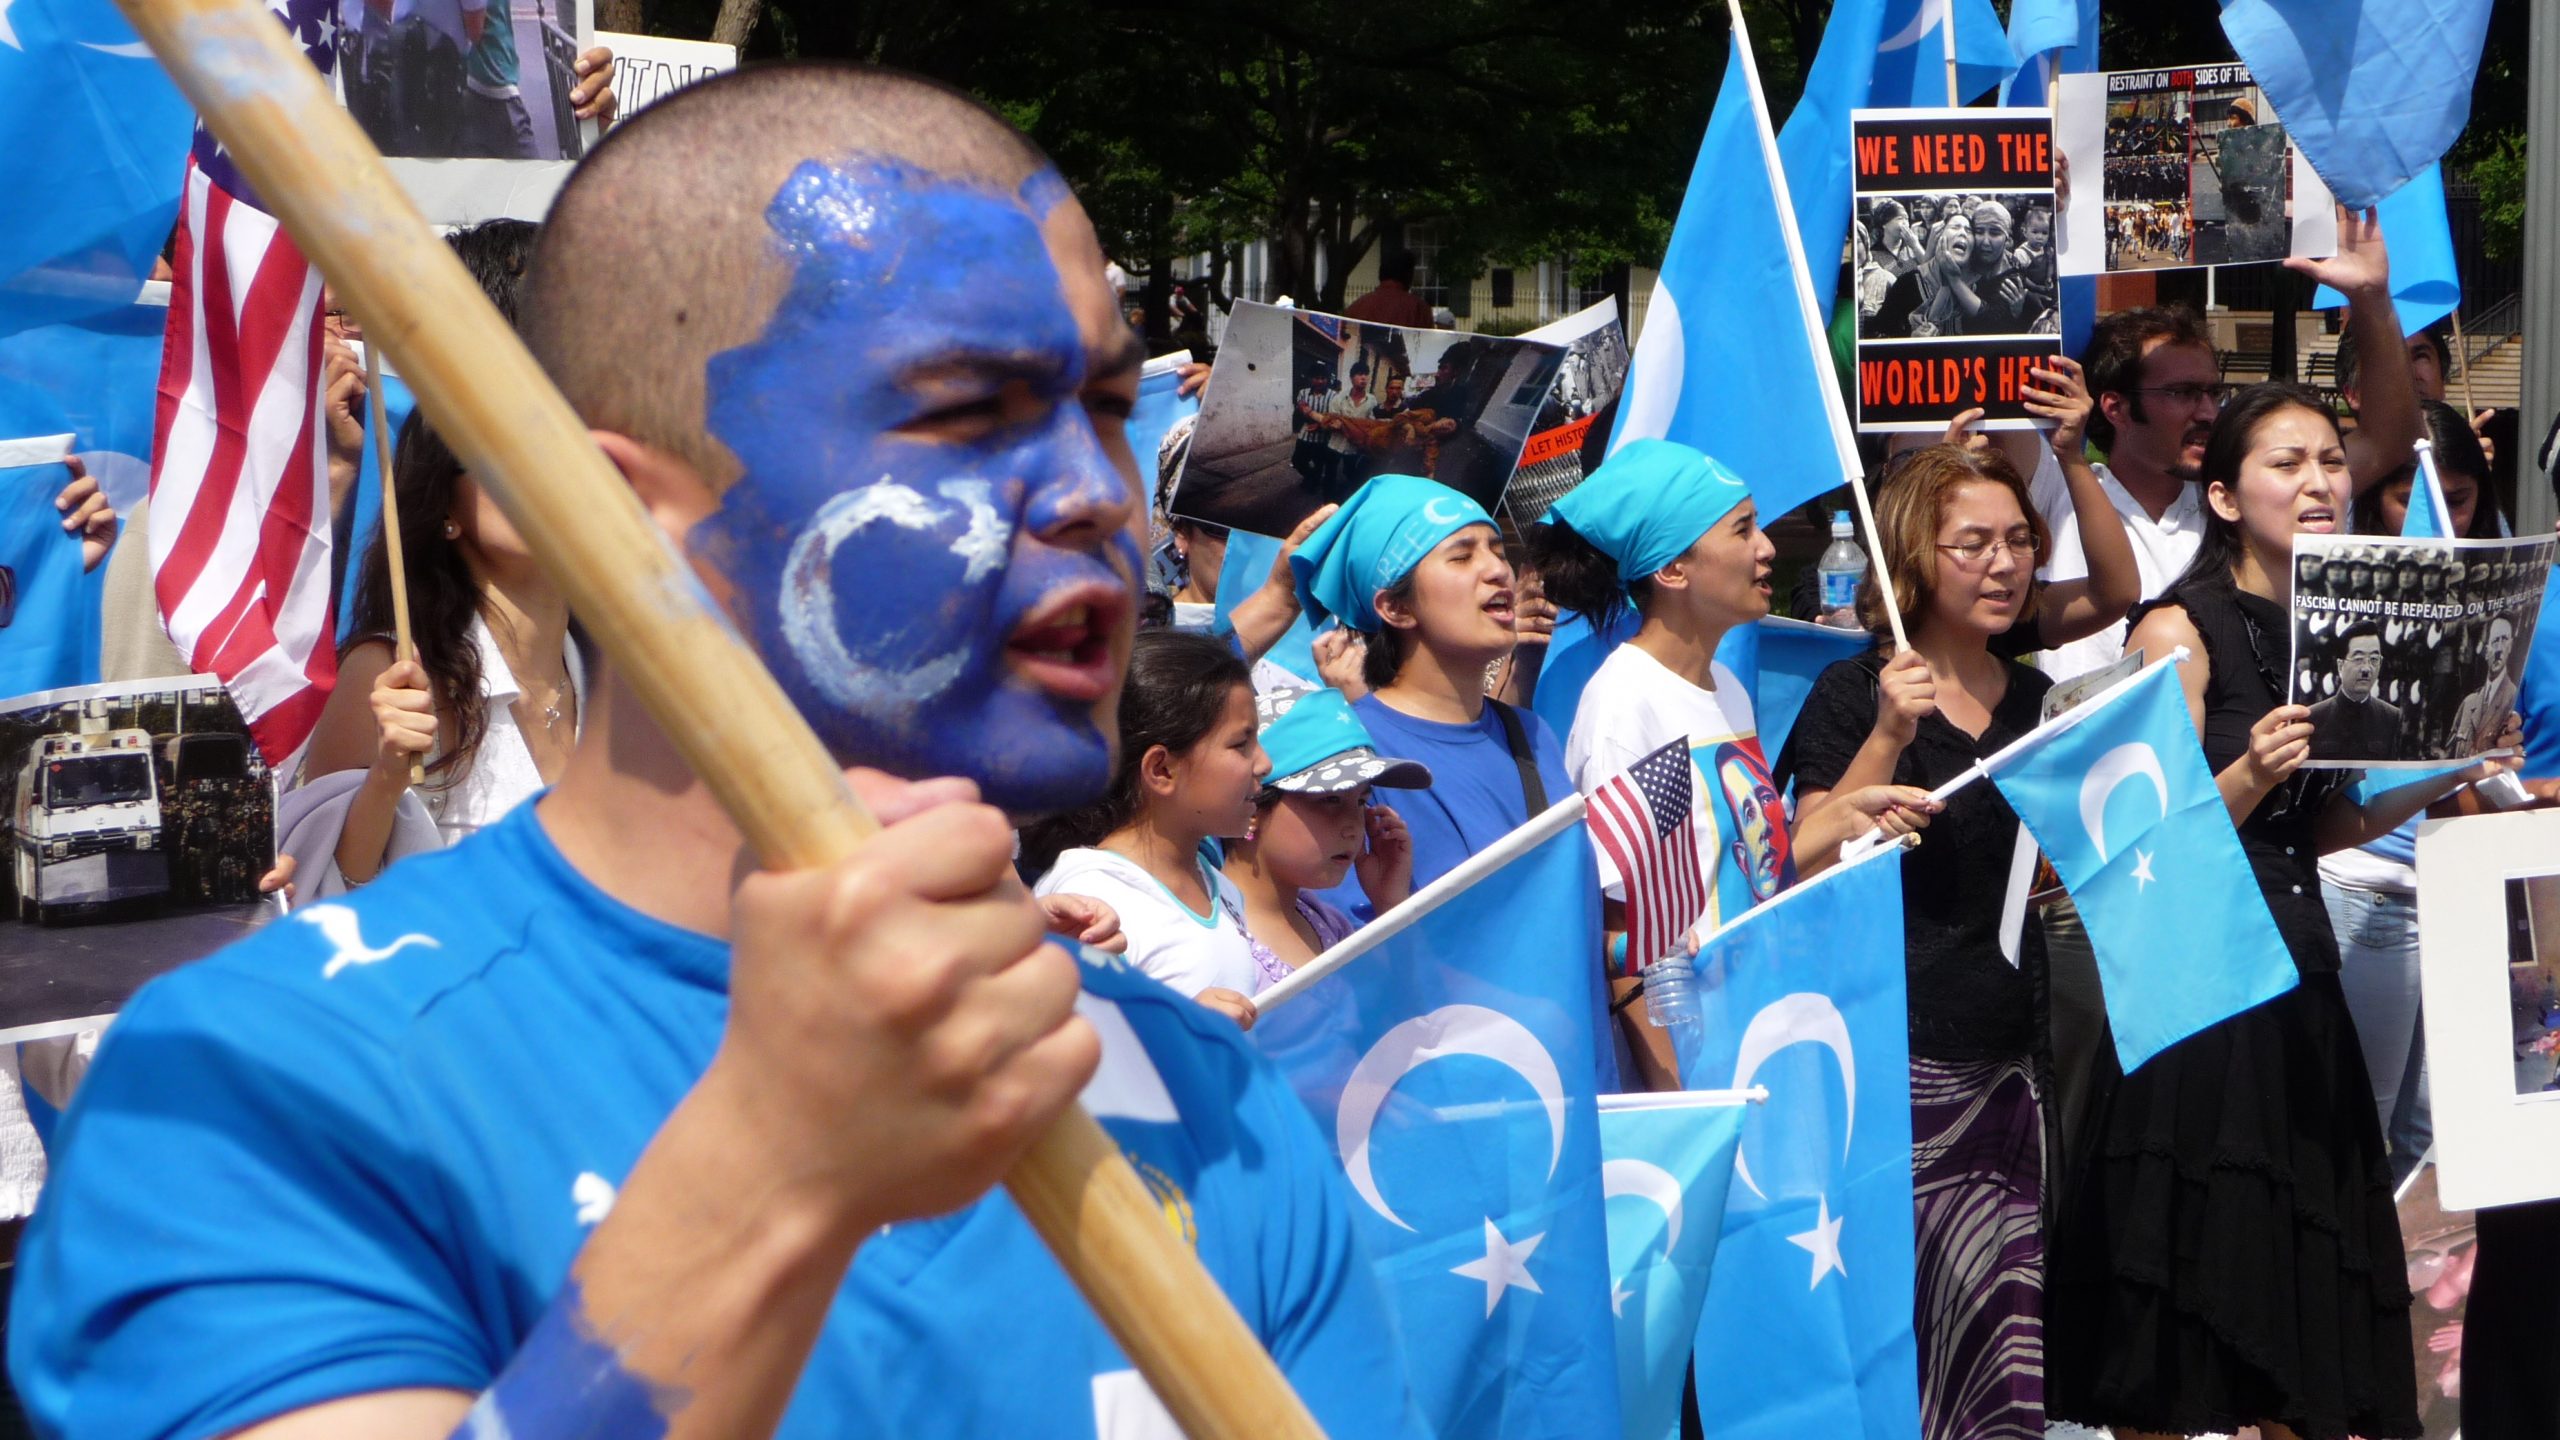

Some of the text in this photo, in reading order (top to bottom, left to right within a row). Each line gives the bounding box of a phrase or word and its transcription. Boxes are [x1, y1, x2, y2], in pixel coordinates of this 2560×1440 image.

[2109, 66, 2251, 91] RESTRAINT ON BOTH SIDES OF THE
[1857, 133, 2049, 176] WE NEED THE
[1860, 357, 1987, 406] WORLD'S
[1530, 438, 1552, 456] LET
[1371, 520, 1436, 592] REE
[2296, 595, 2336, 610] FASCISM
[2339, 598, 2382, 614] CANNOT
[2385, 601, 2398, 616] BE
[2402, 603, 2463, 619] REPEATED
[2467, 601, 2485, 615] ON
[2488, 597, 2505, 611] THE
